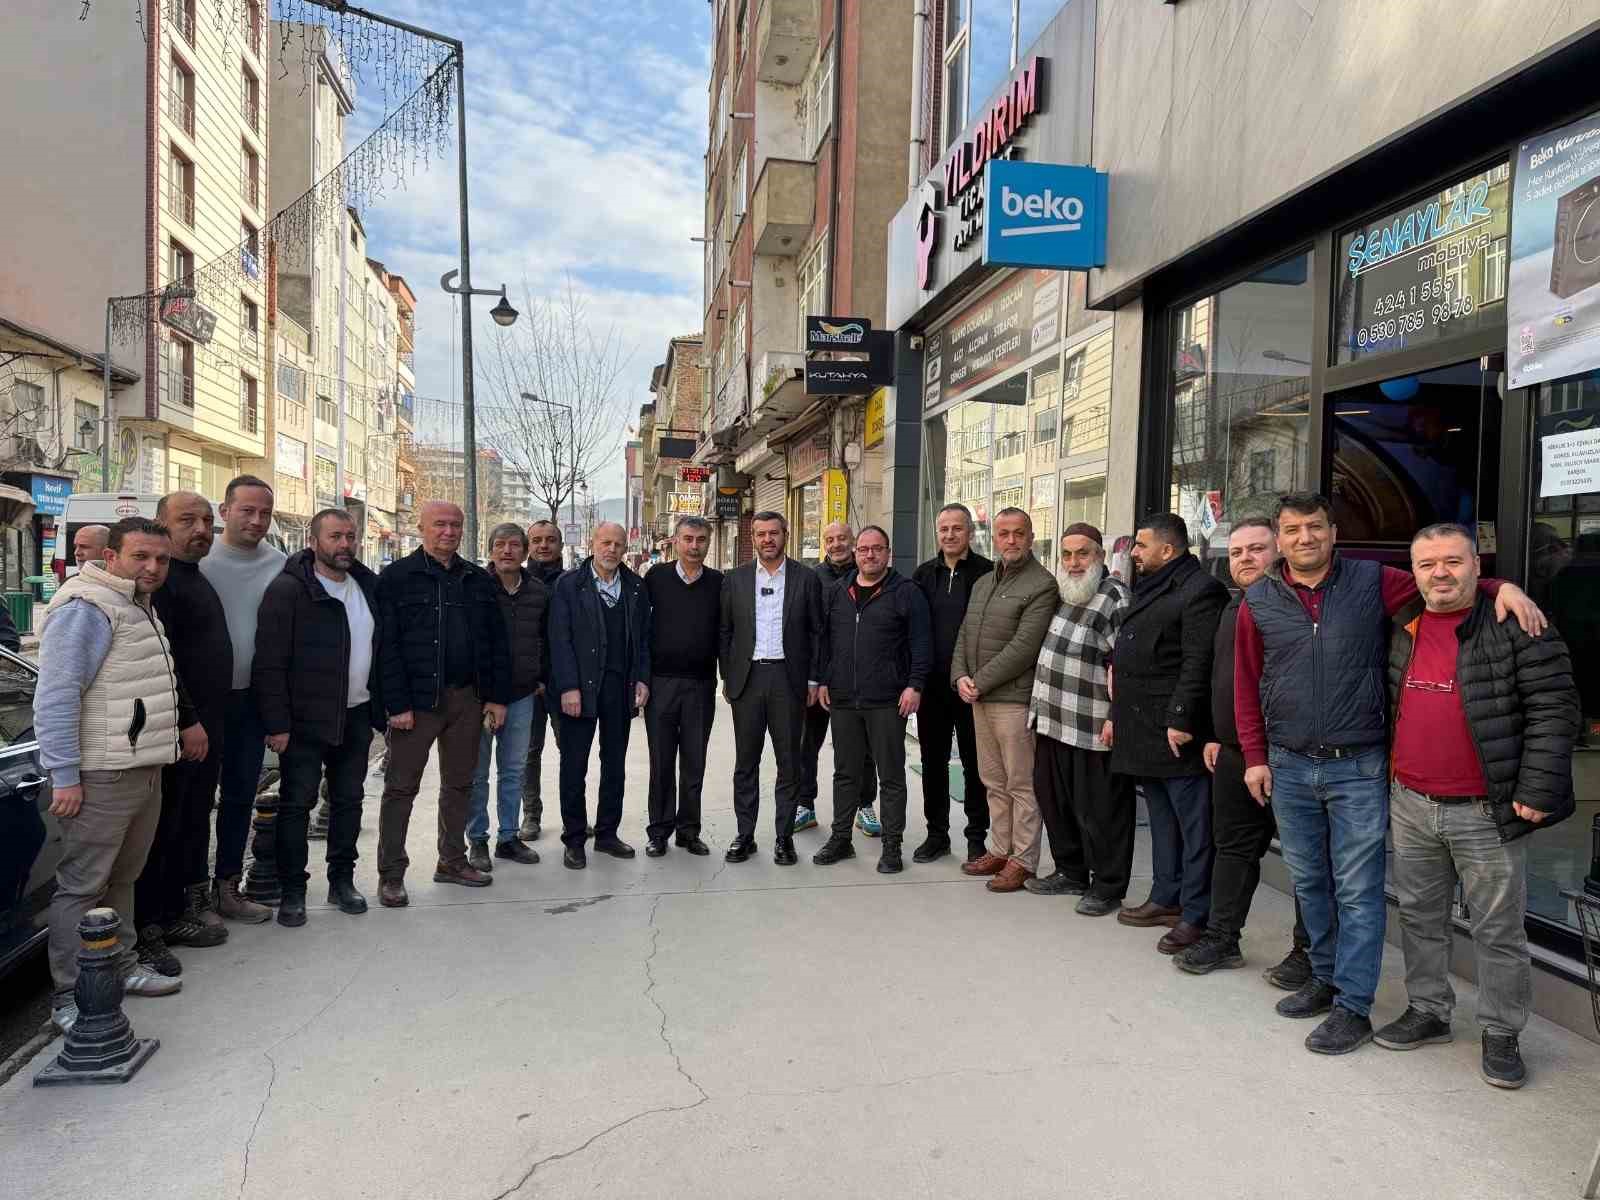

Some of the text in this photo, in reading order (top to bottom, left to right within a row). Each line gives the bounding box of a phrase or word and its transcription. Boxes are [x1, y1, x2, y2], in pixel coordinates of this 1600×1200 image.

[944, 56, 1041, 206] YILDIRIM
[1530, 146, 1553, 169] Beko
[1001, 186, 1084, 221] beko
[1349, 181, 1491, 278] ŞENAYLAR
[1418, 231, 1490, 271] mobilya
[1371, 319, 1395, 343] 530
[1399, 310, 1424, 334] 785
